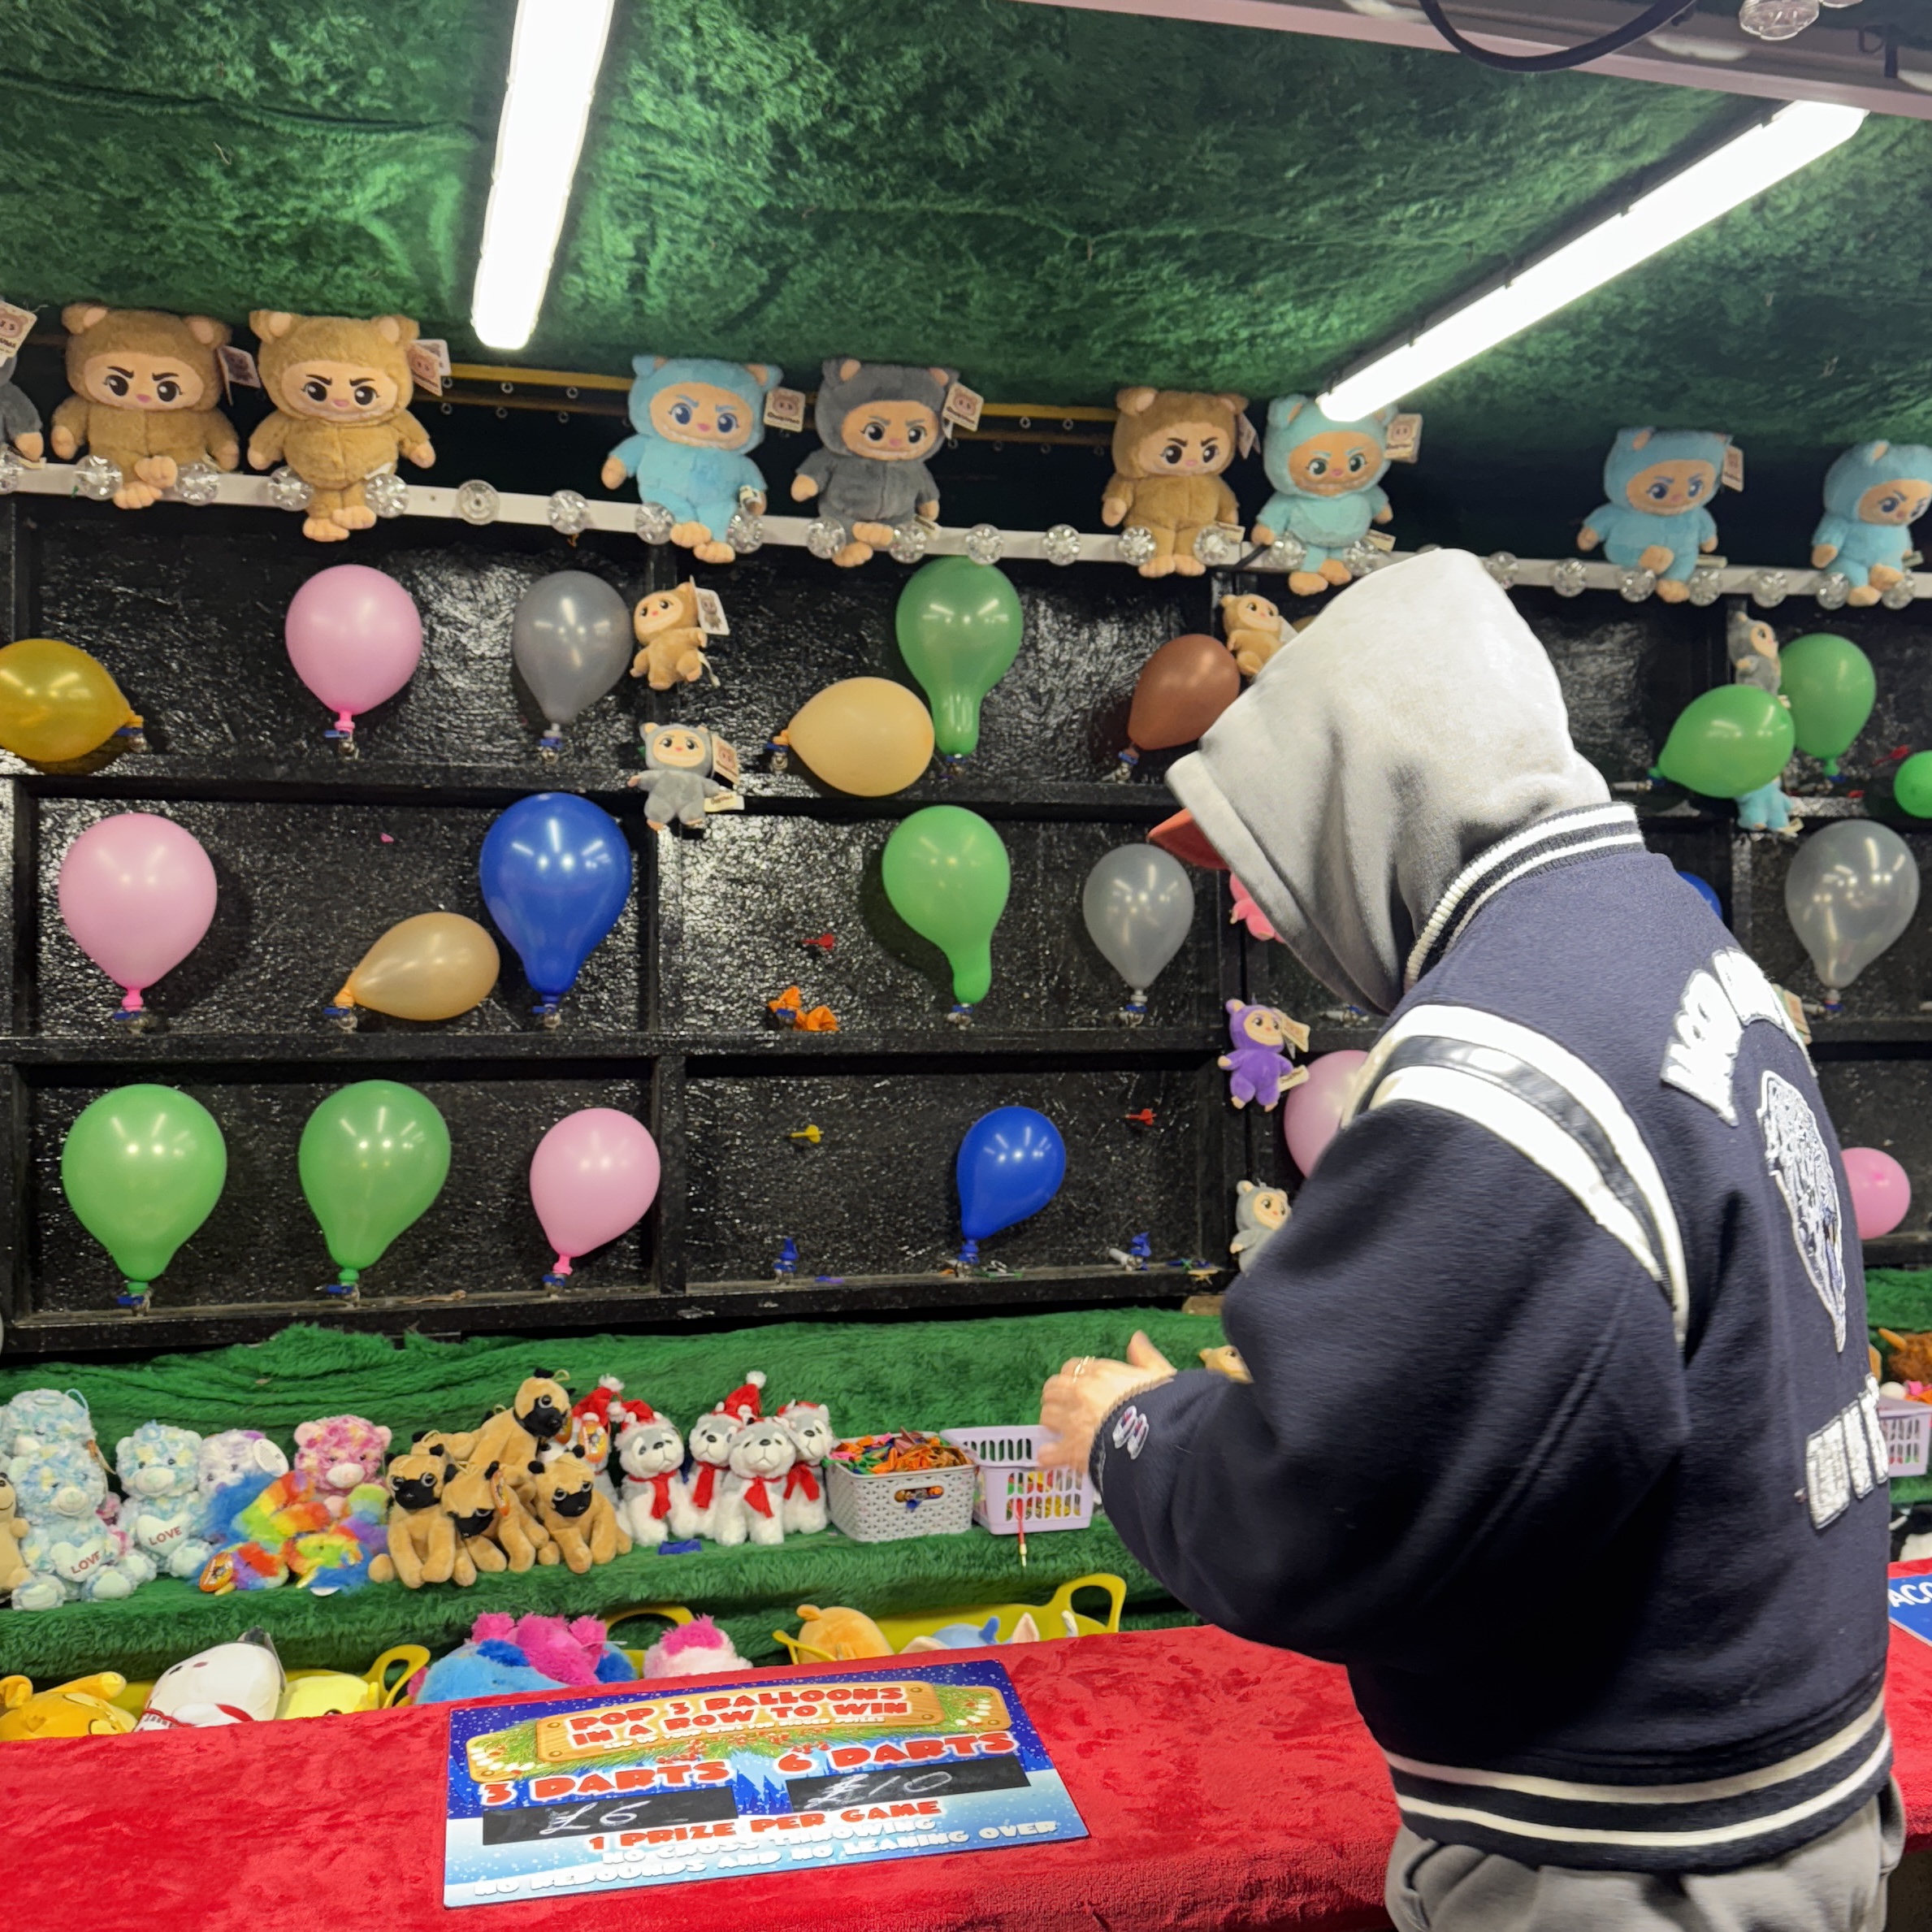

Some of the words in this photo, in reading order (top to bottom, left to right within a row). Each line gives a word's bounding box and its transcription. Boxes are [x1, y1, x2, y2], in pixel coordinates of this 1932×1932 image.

[149, 1526, 183, 1546] LOVE
[71, 1551, 100, 1575] LOVE
[568, 1707, 656, 1732] POP
[668, 1701, 691, 1717] 3
[704, 1687, 903, 1712] BALLOONS
[570, 1728, 612, 1747] IN
[627, 1723, 654, 1736] A
[663, 1709, 756, 1731] ROW
[770, 1705, 819, 1719] TO
[832, 1701, 908, 1716] WIN
[777, 1752, 813, 1773] 6
[830, 1732, 1018, 1769] DARTS
[483, 1783, 517, 1804] 3
[532, 1761, 731, 1800] DARTS
[539, 1800, 651, 1835] £6
[588, 1836, 604, 1851] 1
[620, 1822, 738, 1848] PRIZE
[750, 1813, 826, 1833] PER
[840, 1800, 942, 1823] GAME
[474, 1880, 520, 1896] NO
[531, 1859, 708, 1891] REBOUNDS
[717, 1848, 782, 1869] AND
[791, 1845, 834, 1861] NO
[843, 1829, 971, 1856] LEANING
[977, 1820, 1059, 1841] OVER
[602, 1848, 646, 1865] NO
[656, 1837, 760, 1859] CROSS
[772, 1819, 938, 1847] THROWING
